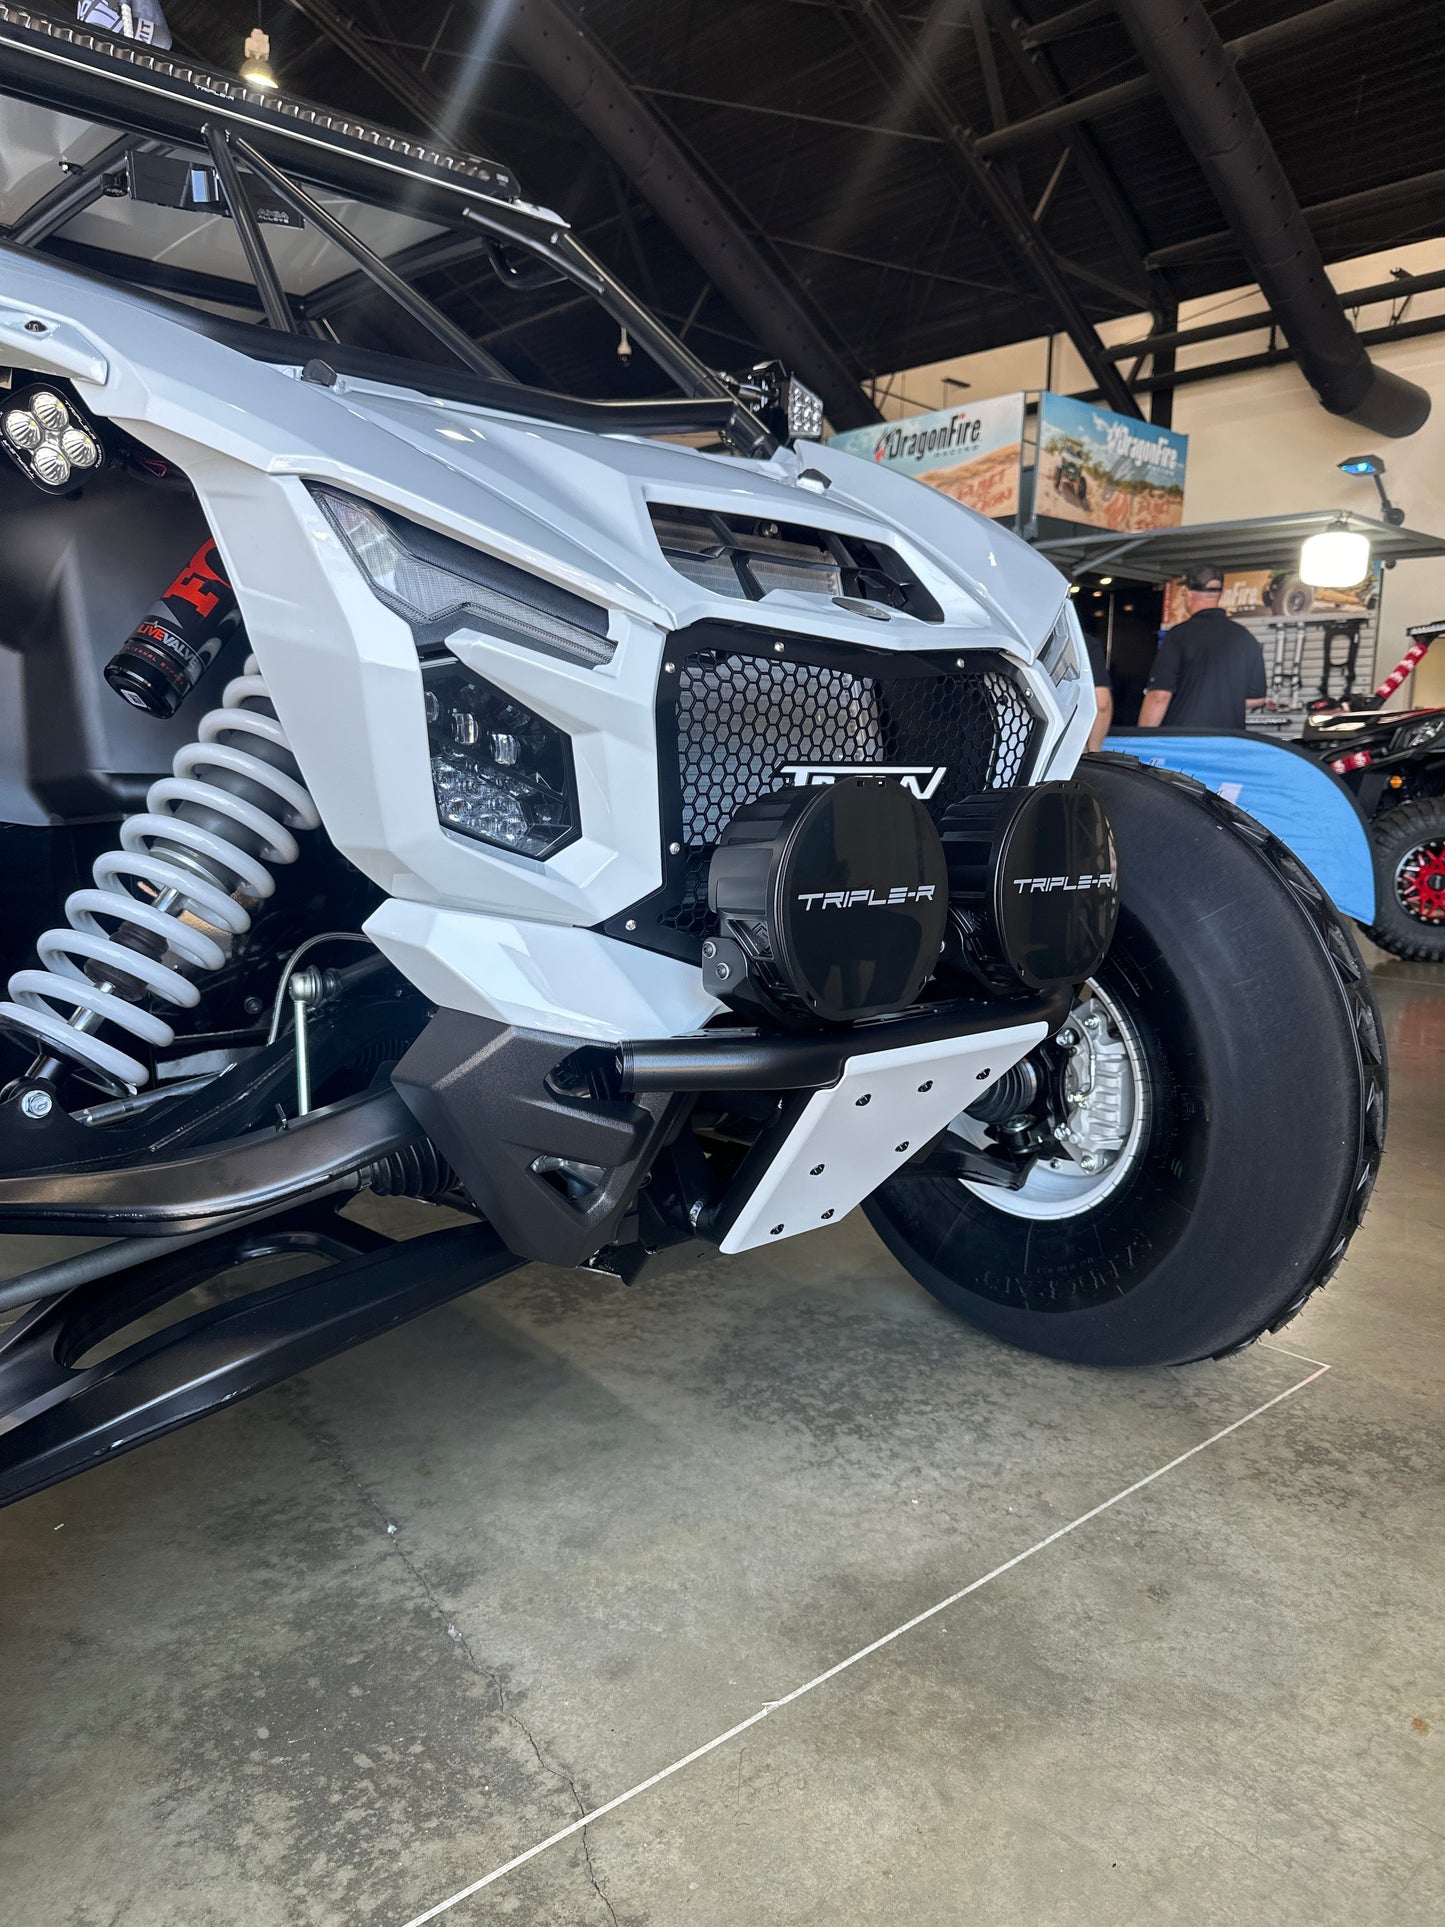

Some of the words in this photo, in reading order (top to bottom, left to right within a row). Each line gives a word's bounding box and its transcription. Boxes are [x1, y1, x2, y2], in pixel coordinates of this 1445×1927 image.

[888, 412, 981, 461] DragonFire
[162, 537, 232, 618] FO
[797, 884, 936, 911] TRIPLE-R
[1013, 873, 1113, 895] TRIPLE-R
